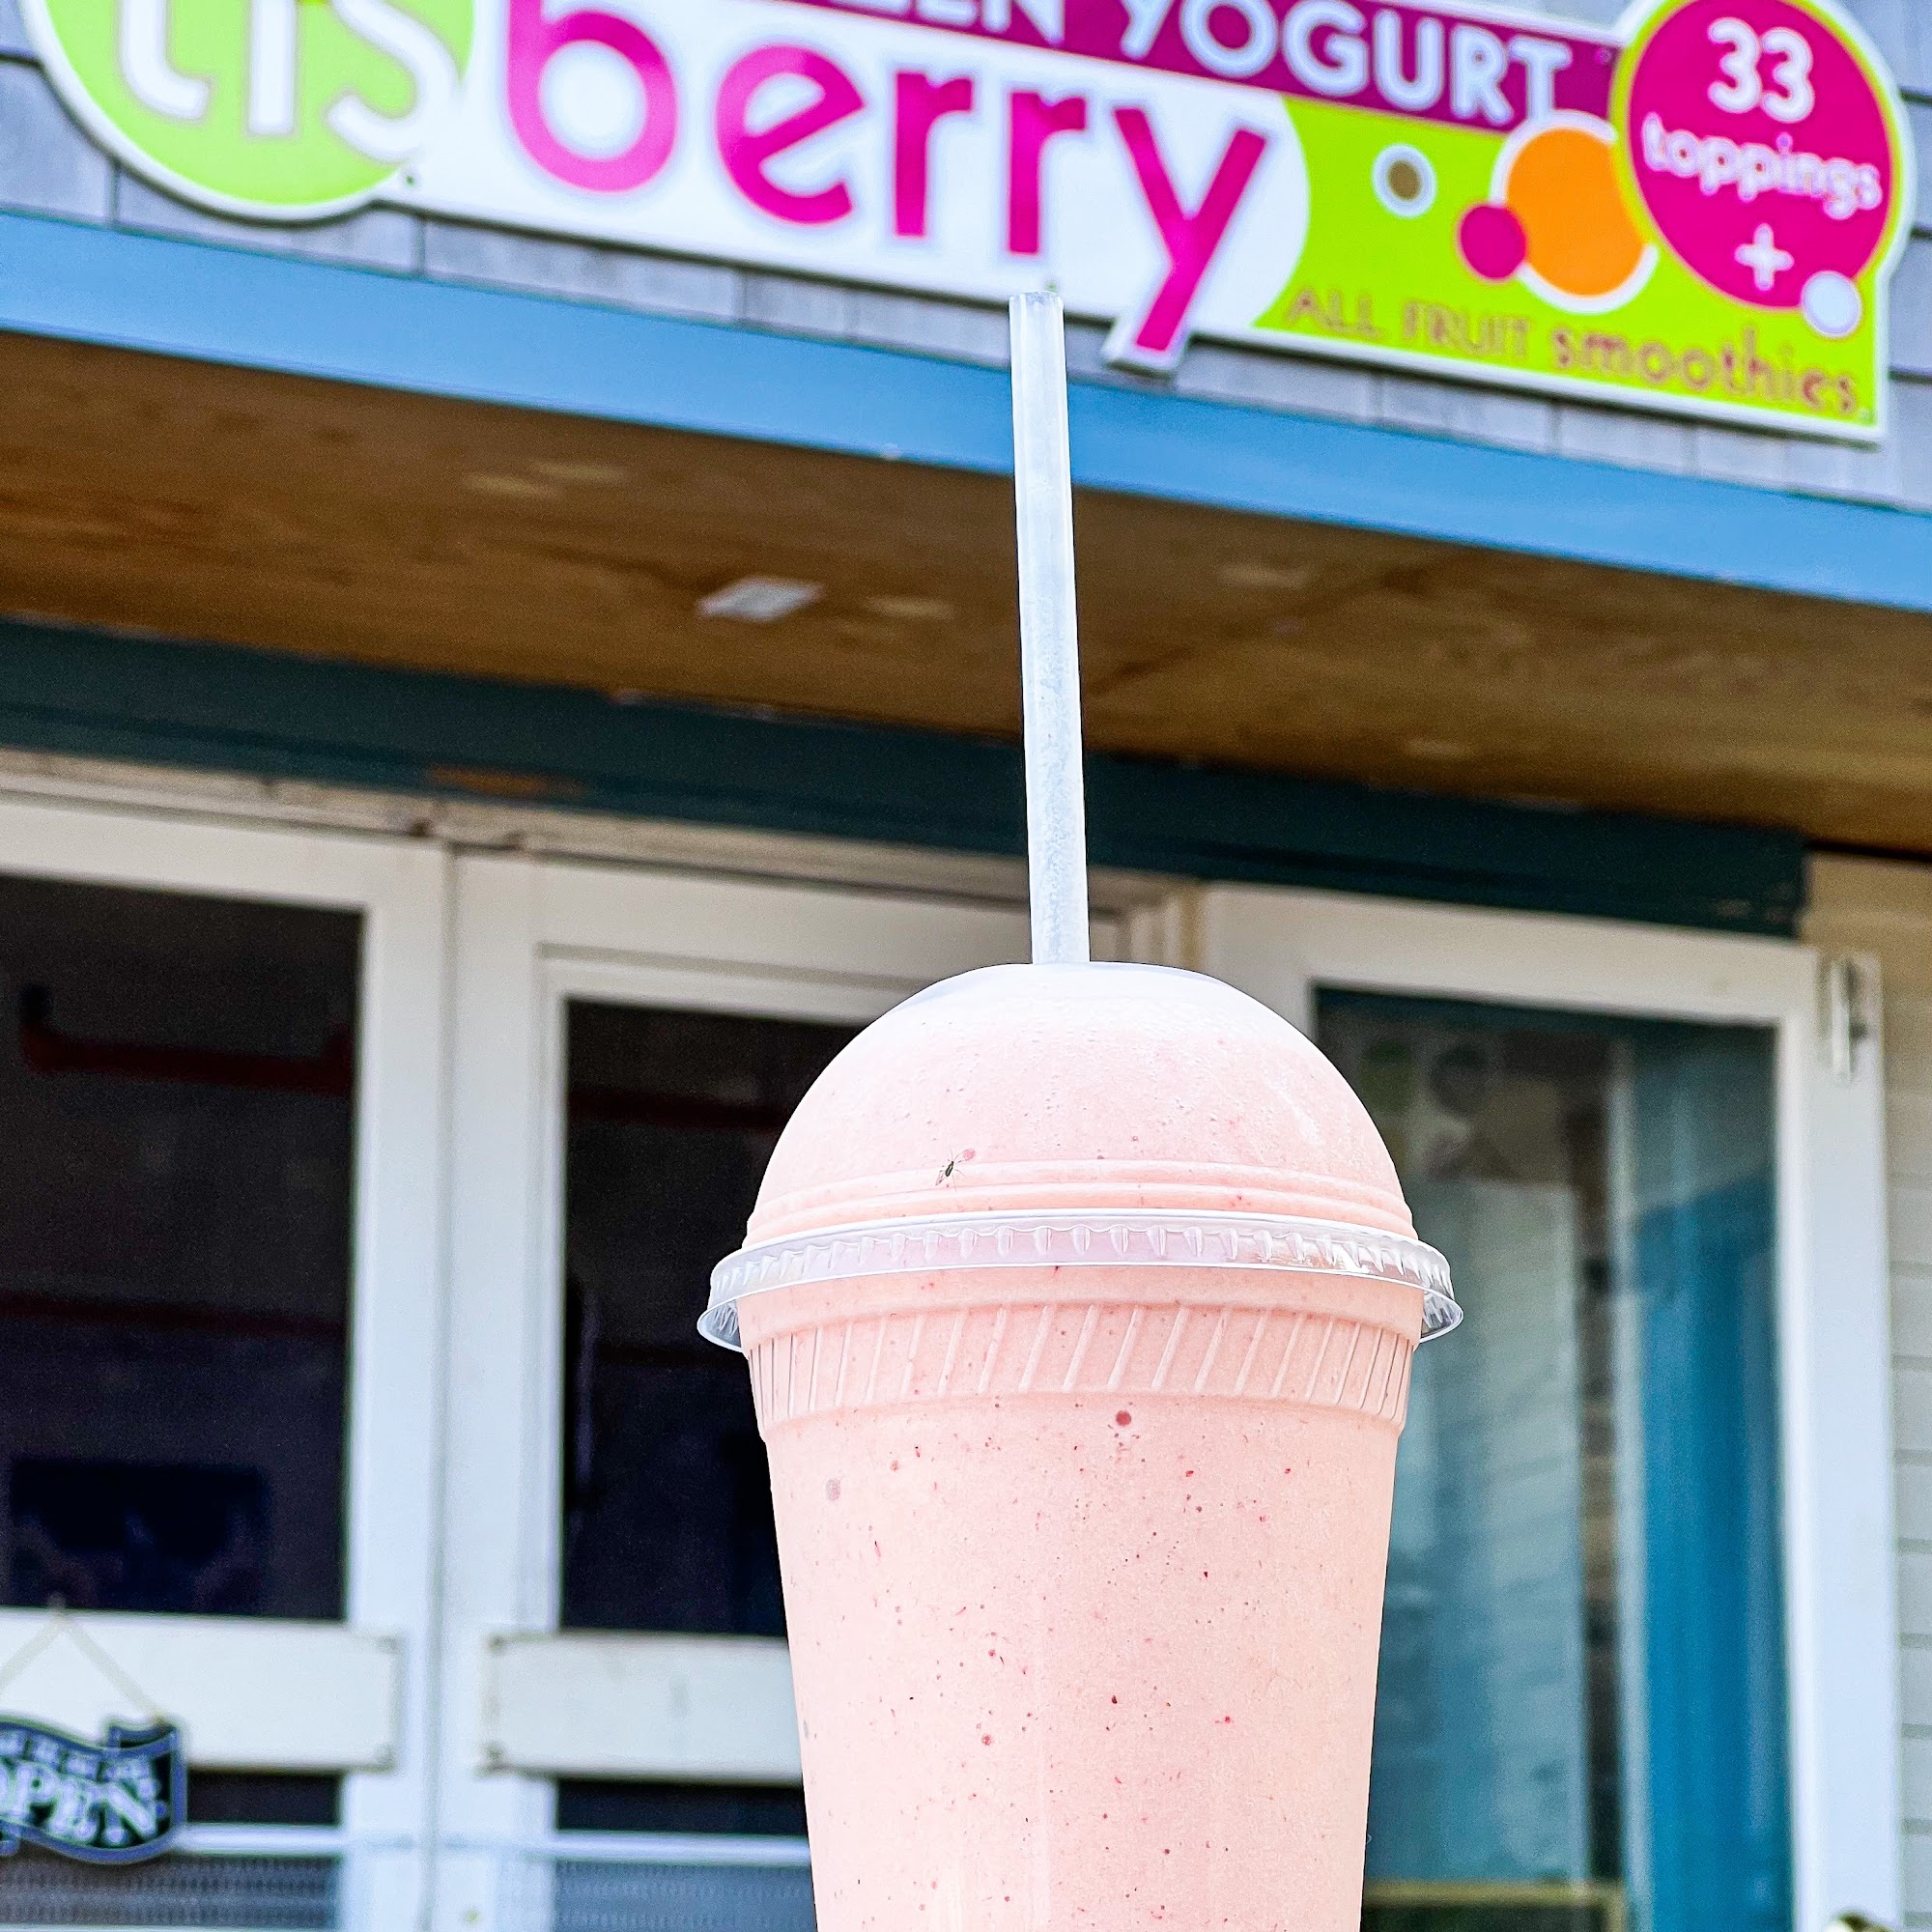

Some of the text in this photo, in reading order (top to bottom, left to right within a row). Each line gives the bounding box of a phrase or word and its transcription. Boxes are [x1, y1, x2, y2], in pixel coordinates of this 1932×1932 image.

[1708, 17, 1814, 123] 33
[1642, 112, 1882, 220] toppings
[1285, 287, 1389, 342] ALL
[1552, 327, 1858, 416] smoothies
[0, 1762, 158, 1841] PEN
